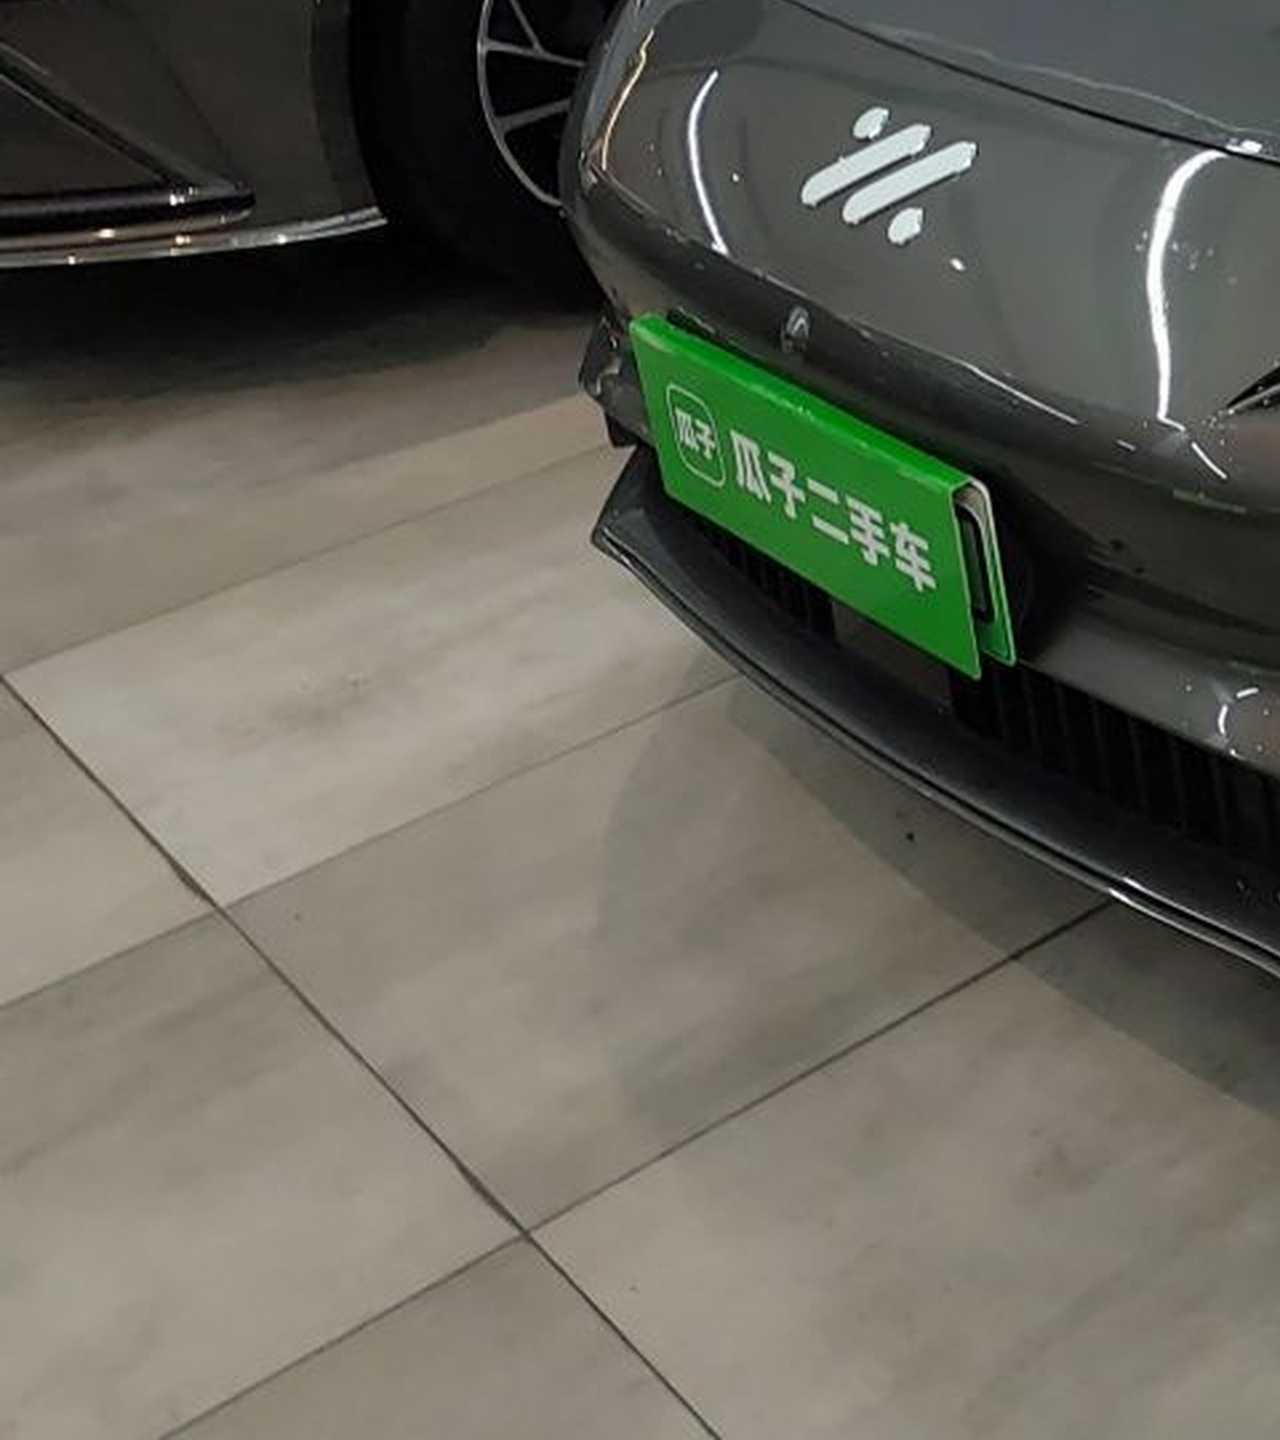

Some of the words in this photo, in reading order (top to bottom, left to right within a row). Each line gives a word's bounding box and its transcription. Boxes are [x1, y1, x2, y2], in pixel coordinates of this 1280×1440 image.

[674, 407, 716, 460] 瓜子
[729, 427, 937, 594] 瓜子二手车
